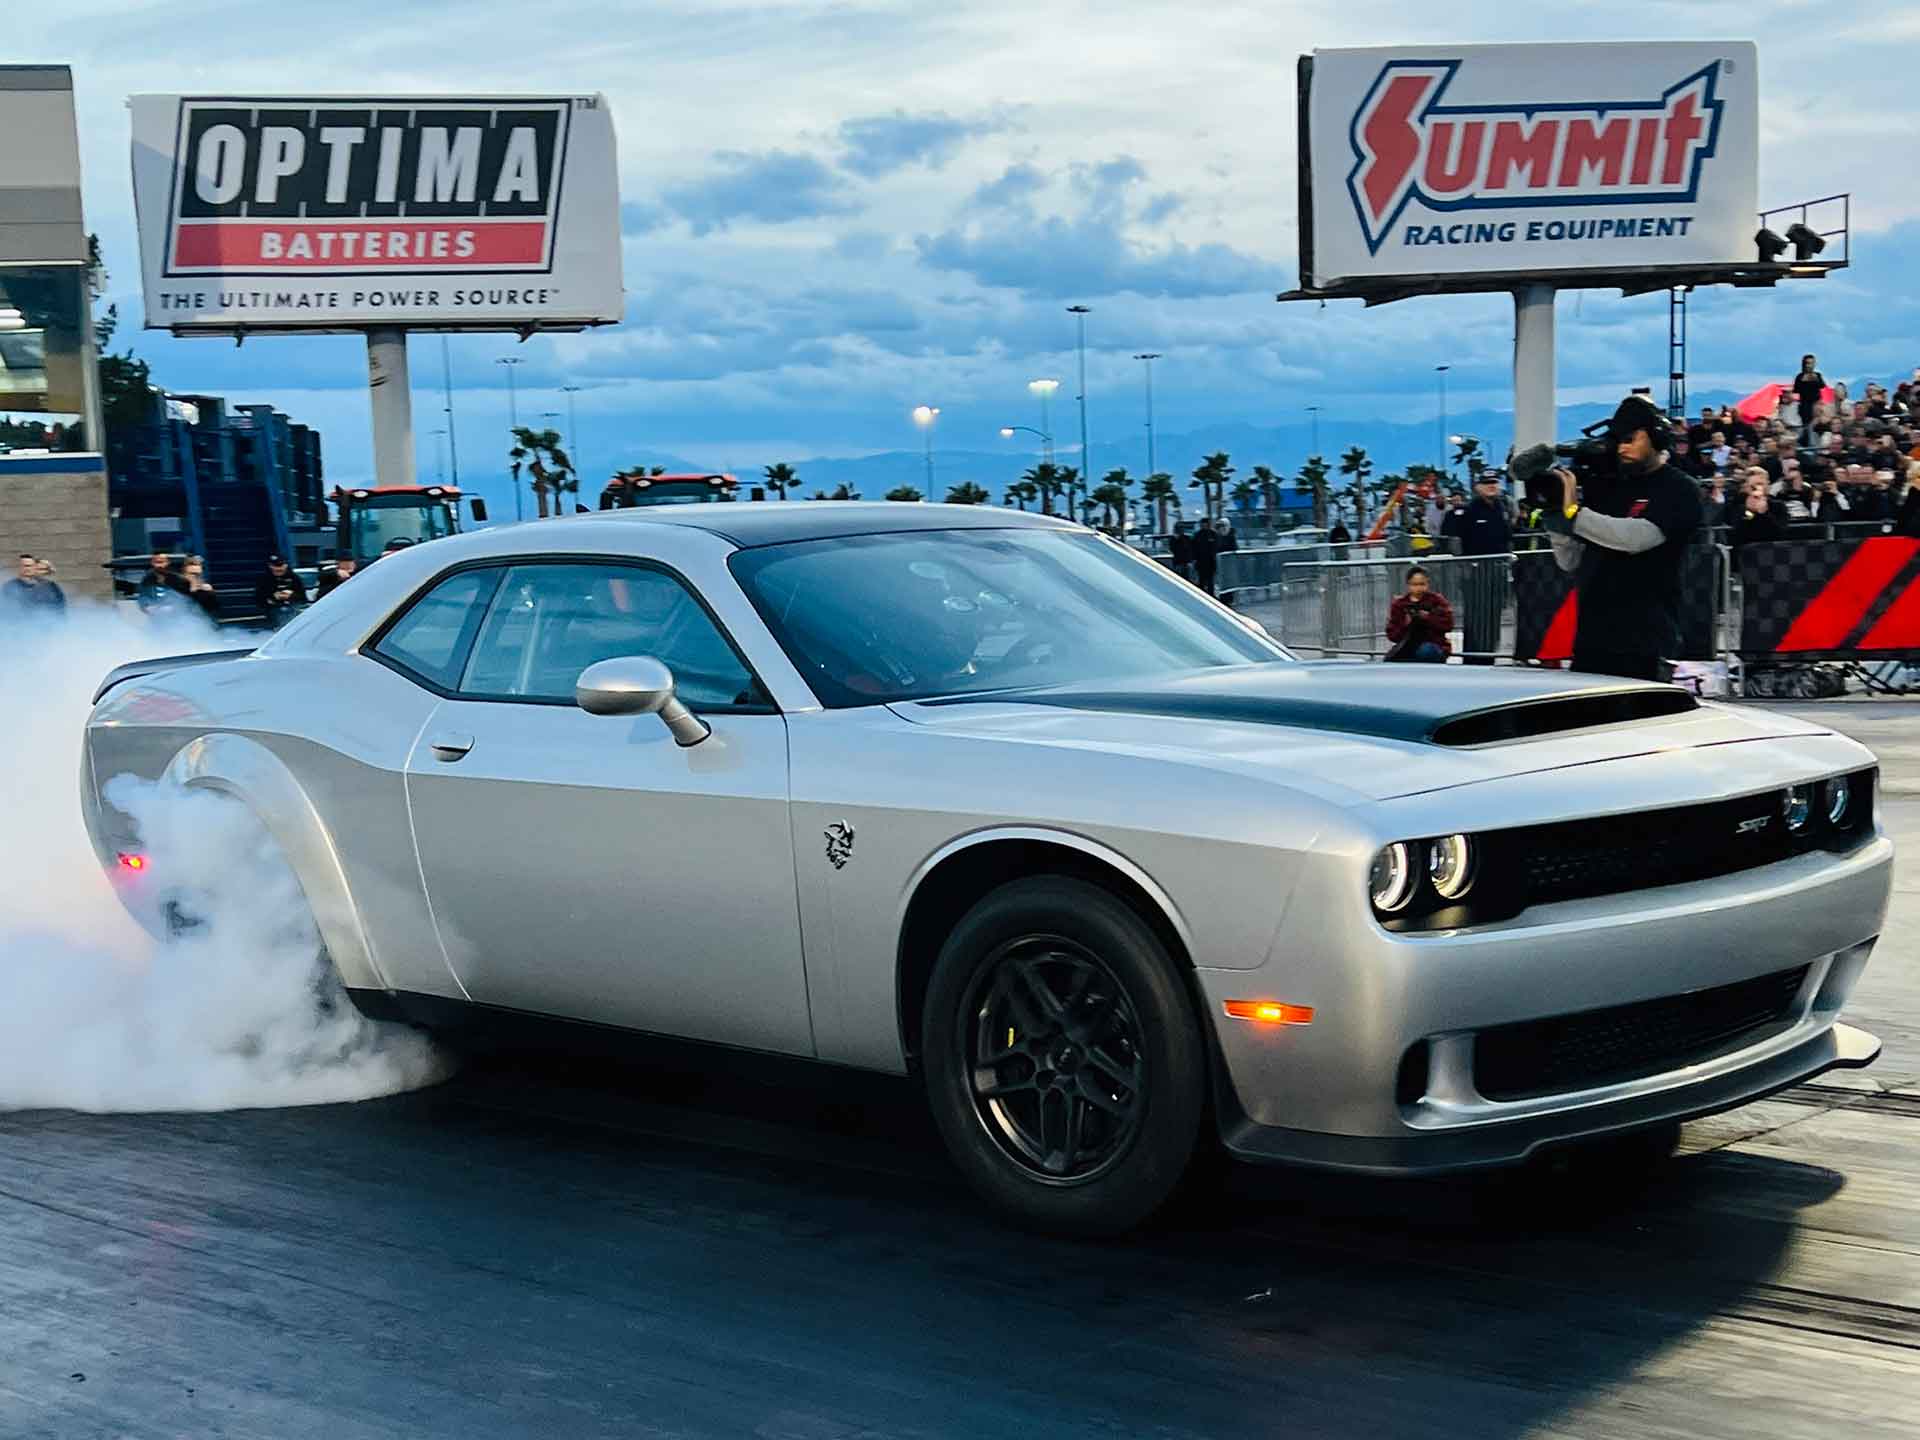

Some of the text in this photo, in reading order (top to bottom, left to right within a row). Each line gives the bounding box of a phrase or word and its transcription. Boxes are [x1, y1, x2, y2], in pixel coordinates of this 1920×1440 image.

[195, 124, 540, 204] OPTIMA
[260, 231, 476, 260] BATTERIES
[1403, 217, 1694, 246] RACING EQUIPMENT
[160, 293, 205, 309] THE
[219, 292, 339, 308] ULTIMATE
[353, 290, 440, 307] POWER
[1735, 815, 1771, 833] SRT
